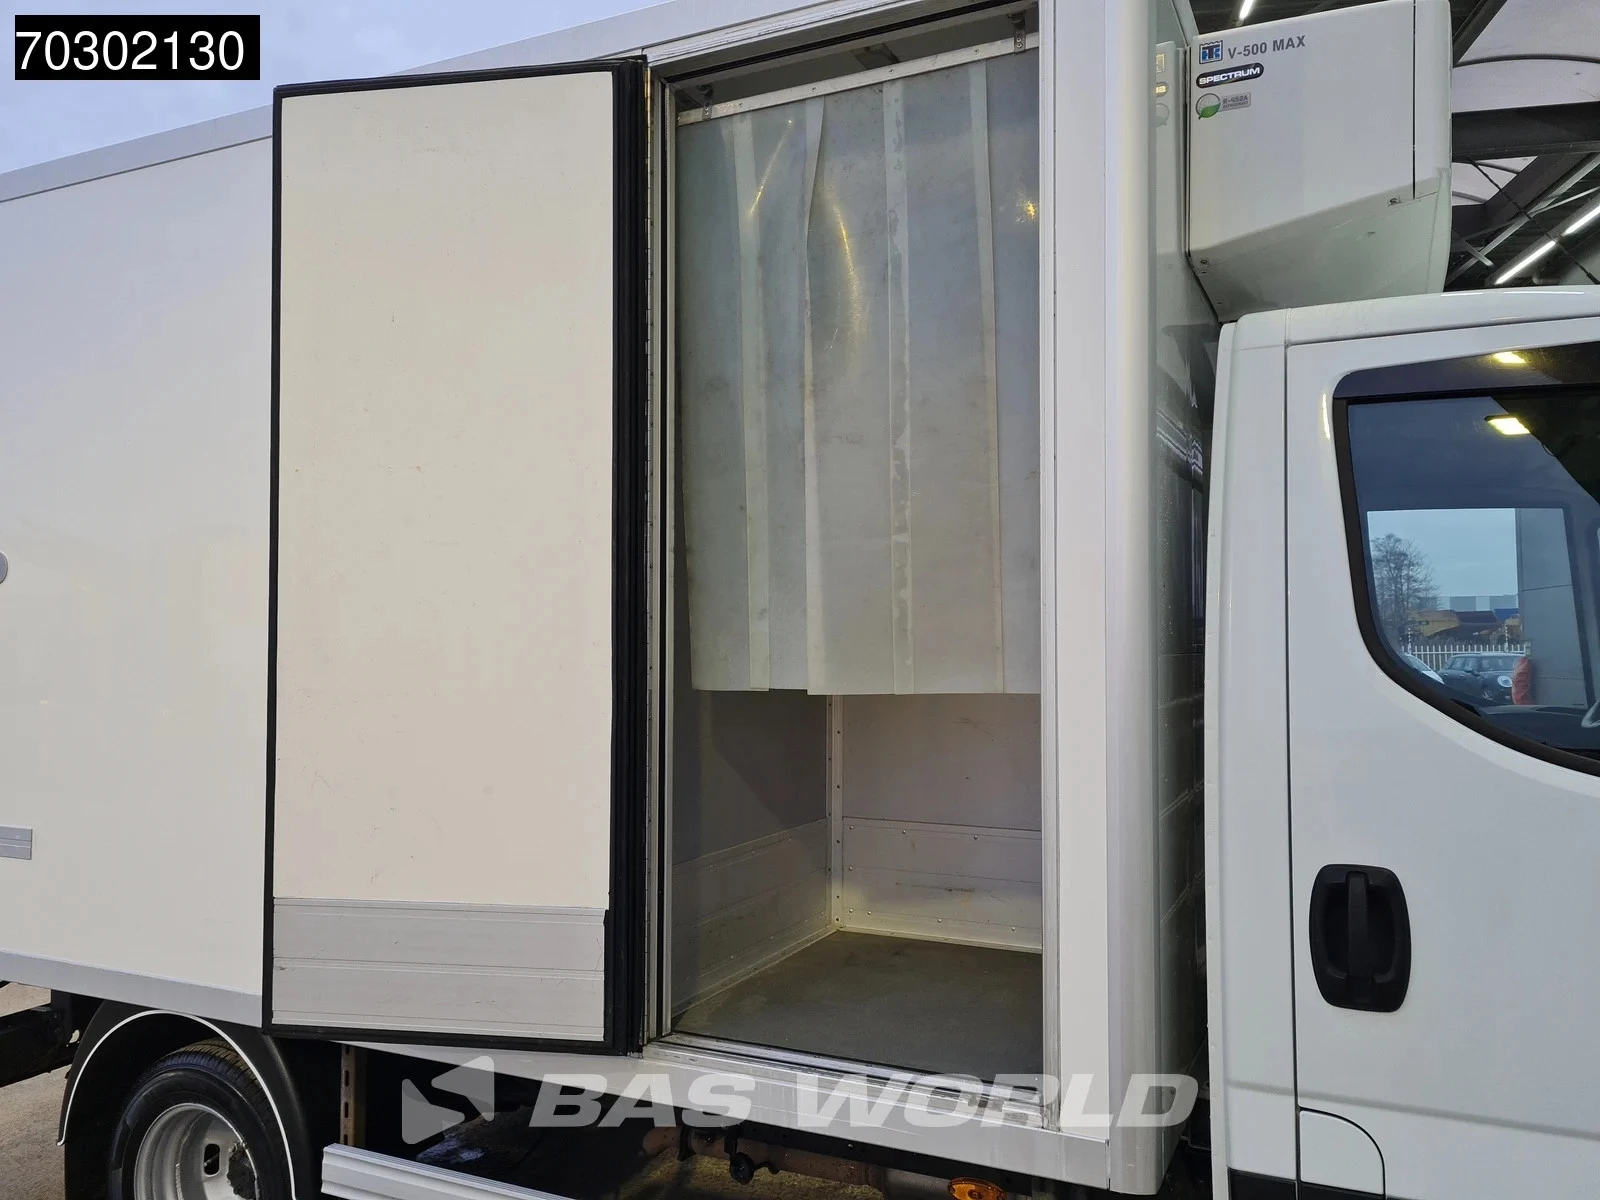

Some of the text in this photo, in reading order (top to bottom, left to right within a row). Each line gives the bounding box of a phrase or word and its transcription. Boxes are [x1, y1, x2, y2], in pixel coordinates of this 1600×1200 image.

[1228, 35, 1306, 59] V-500 MAX
[1199, 67, 1260, 85] SPECTRUM
